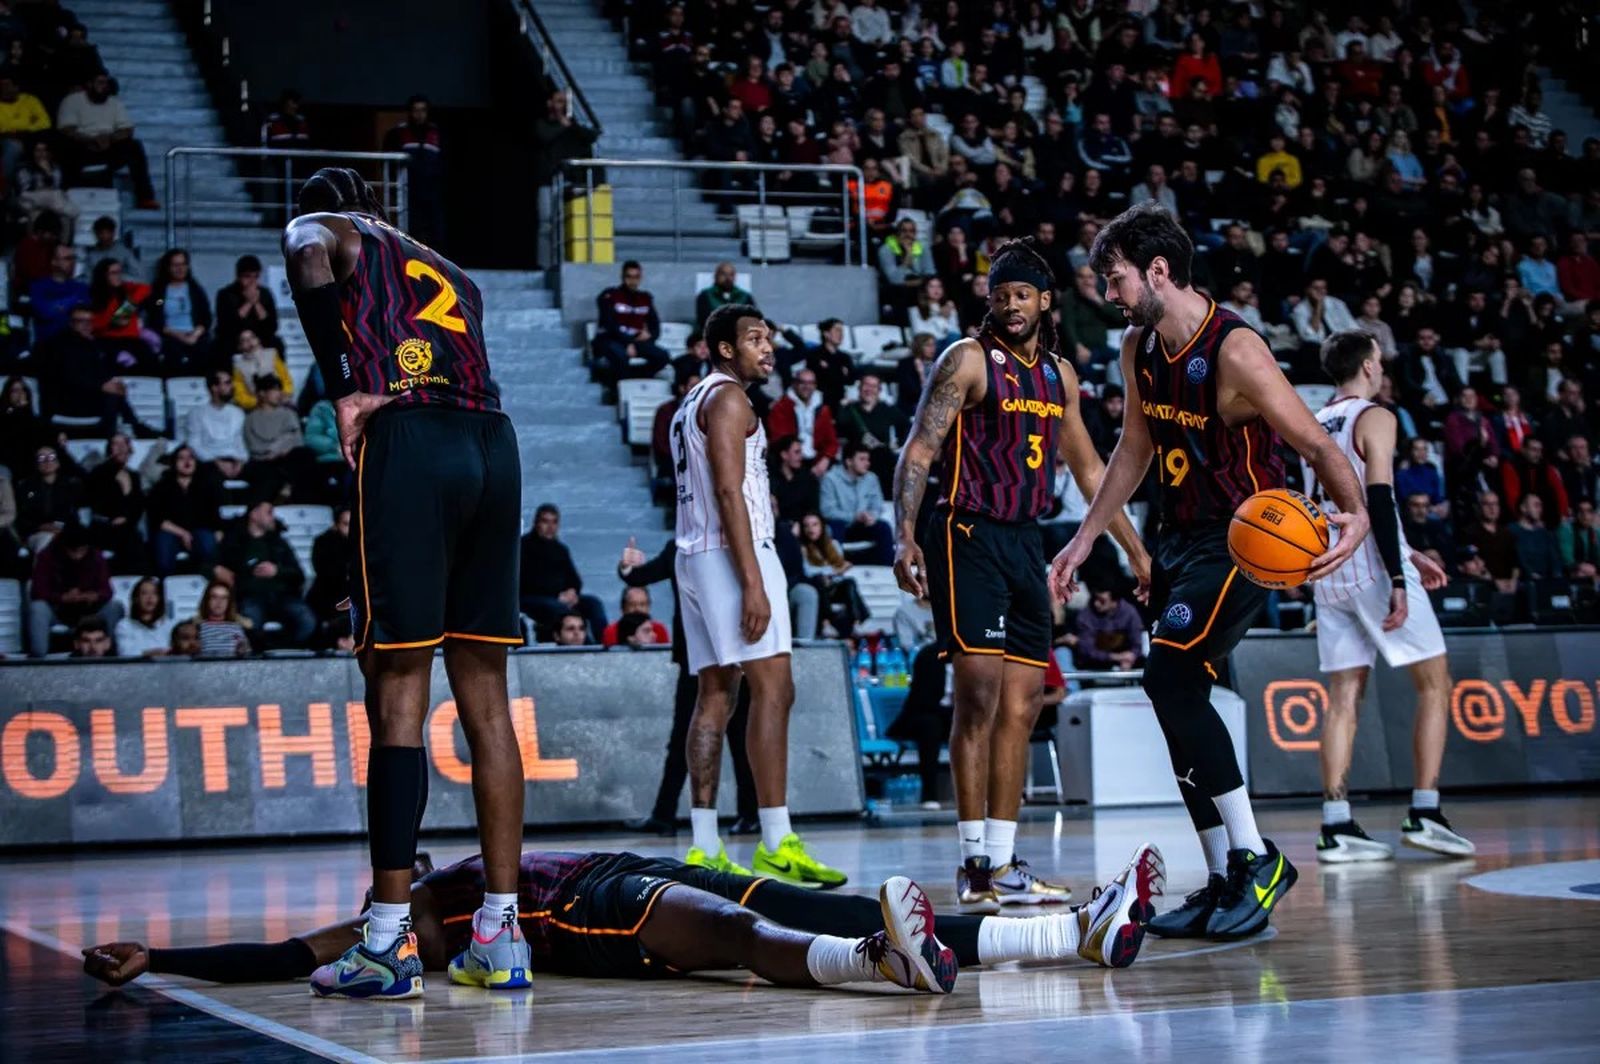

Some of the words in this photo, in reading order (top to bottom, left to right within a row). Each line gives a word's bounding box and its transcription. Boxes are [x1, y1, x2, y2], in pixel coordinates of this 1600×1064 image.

[405, 259, 467, 333] 2
[1141, 400, 1209, 431] GALATAARAY
[1026, 434, 1044, 469] 3
[1157, 445, 1190, 487] 19
[1260, 509, 1284, 526] FIBA
[1451, 679, 1600, 741] @YO
